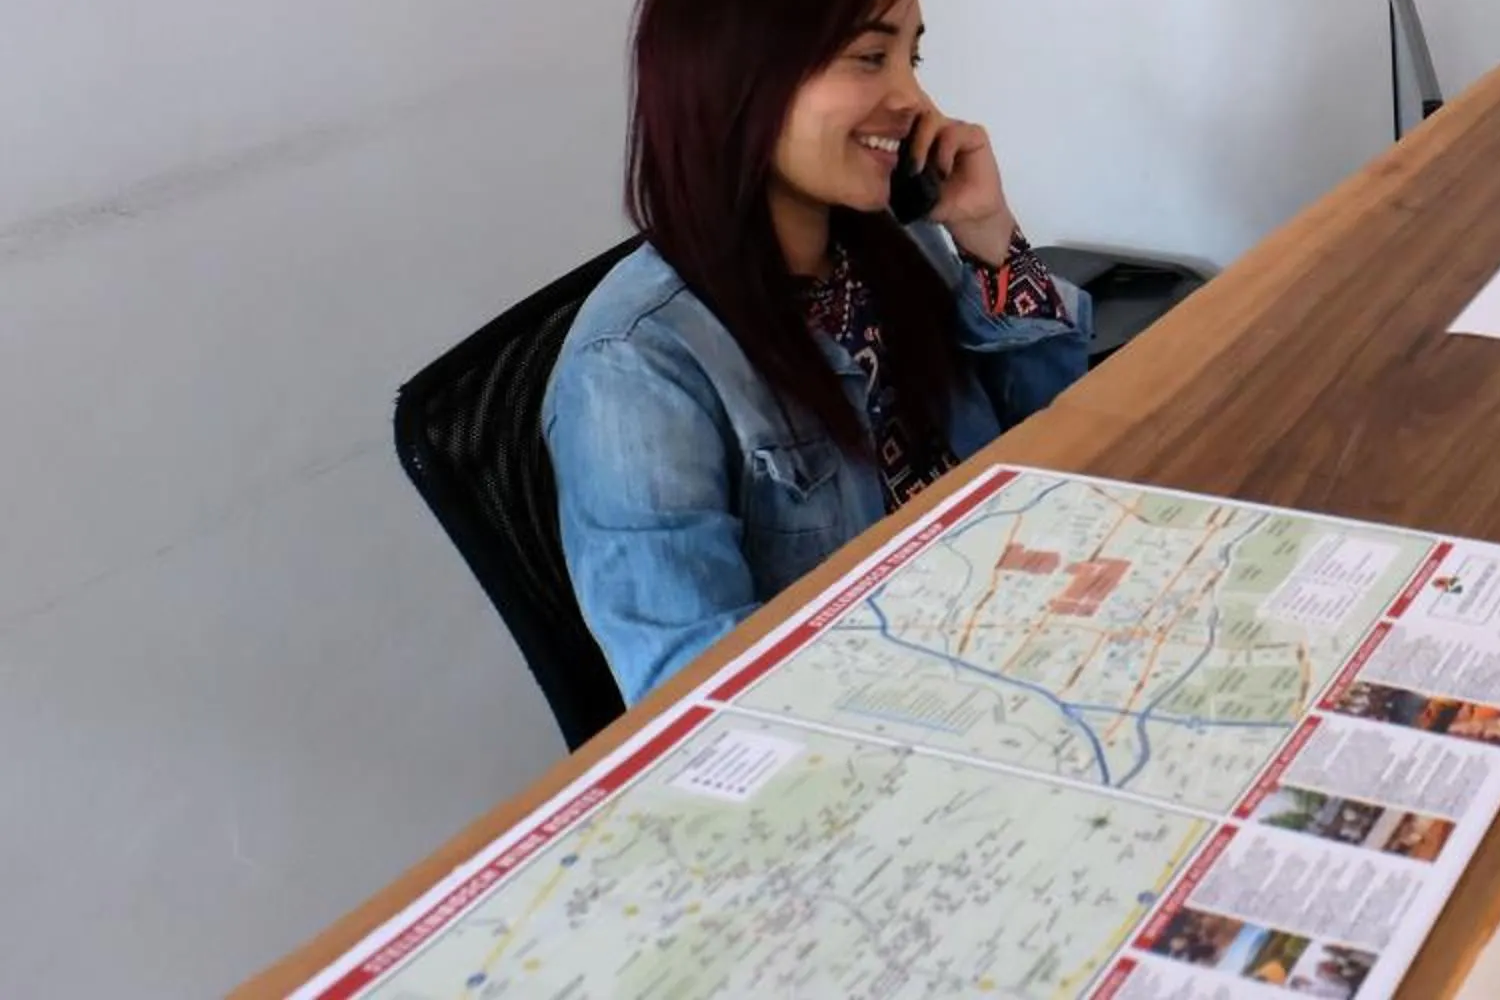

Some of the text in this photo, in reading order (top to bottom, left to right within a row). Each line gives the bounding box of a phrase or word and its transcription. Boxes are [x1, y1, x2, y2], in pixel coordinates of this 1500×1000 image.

[807, 521, 945, 628] STELLENBOSCH TOWN MAP
[361, 867, 502, 974] STELLENBOSCH
[495, 832, 546, 869] WINE
